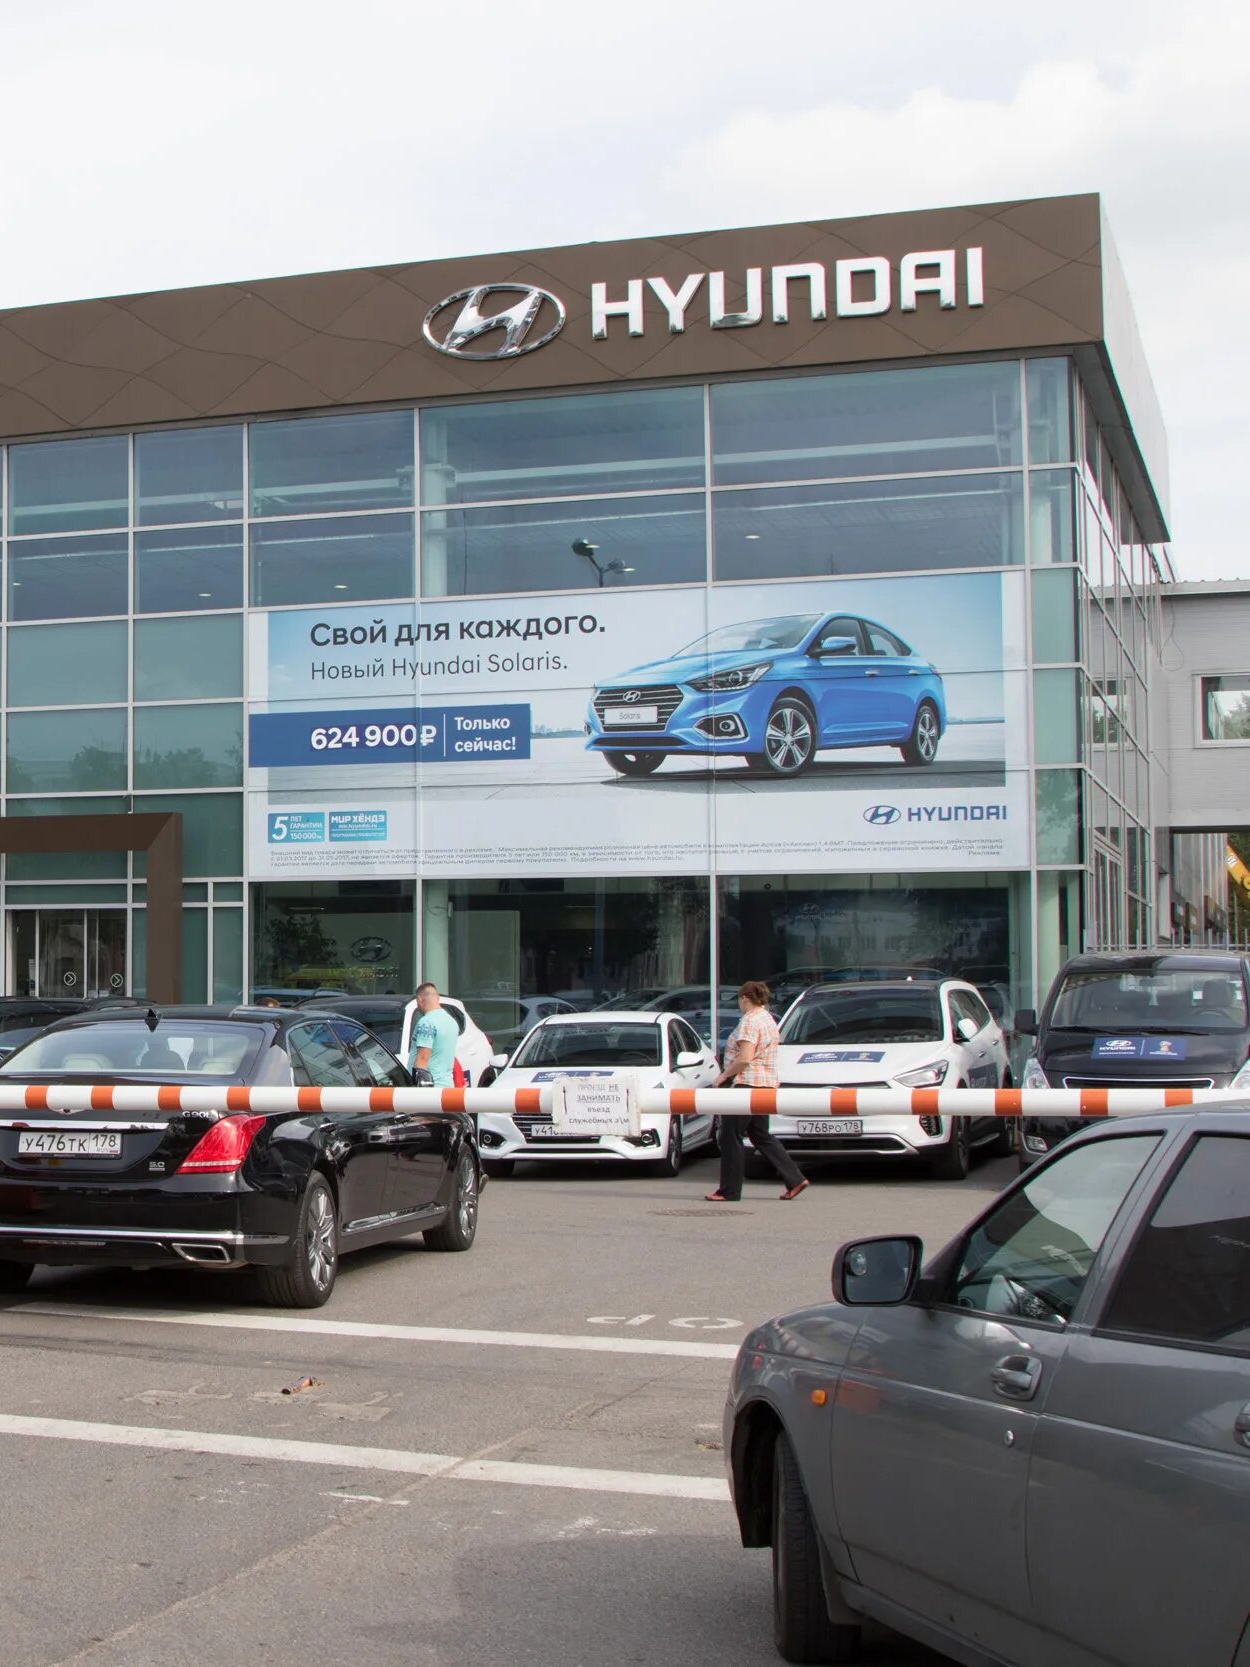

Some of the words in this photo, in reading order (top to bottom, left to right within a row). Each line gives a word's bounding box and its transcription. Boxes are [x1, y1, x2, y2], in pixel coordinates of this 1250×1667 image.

[591, 246, 984, 340] HYUNDAI
[310, 618, 387, 647] Свой
[394, 621, 450, 646] для
[459, 613, 605, 641] каждого.
[311, 658, 384, 680] Новый
[391, 653, 480, 680] Hyundai
[487, 651, 568, 673] Solaris.
[454, 715, 510, 731] Только
[311, 727, 359, 750] 624
[454, 736, 516, 754] сейчас!
[907, 805, 1007, 822] HYUNDAI
[272, 816, 288, 841] 5
[608, 1083, 619, 1091] НЕ
[577, 1094, 621, 1103] ЗАНИМАТЬ
[92, 1133, 117, 1148] 178
